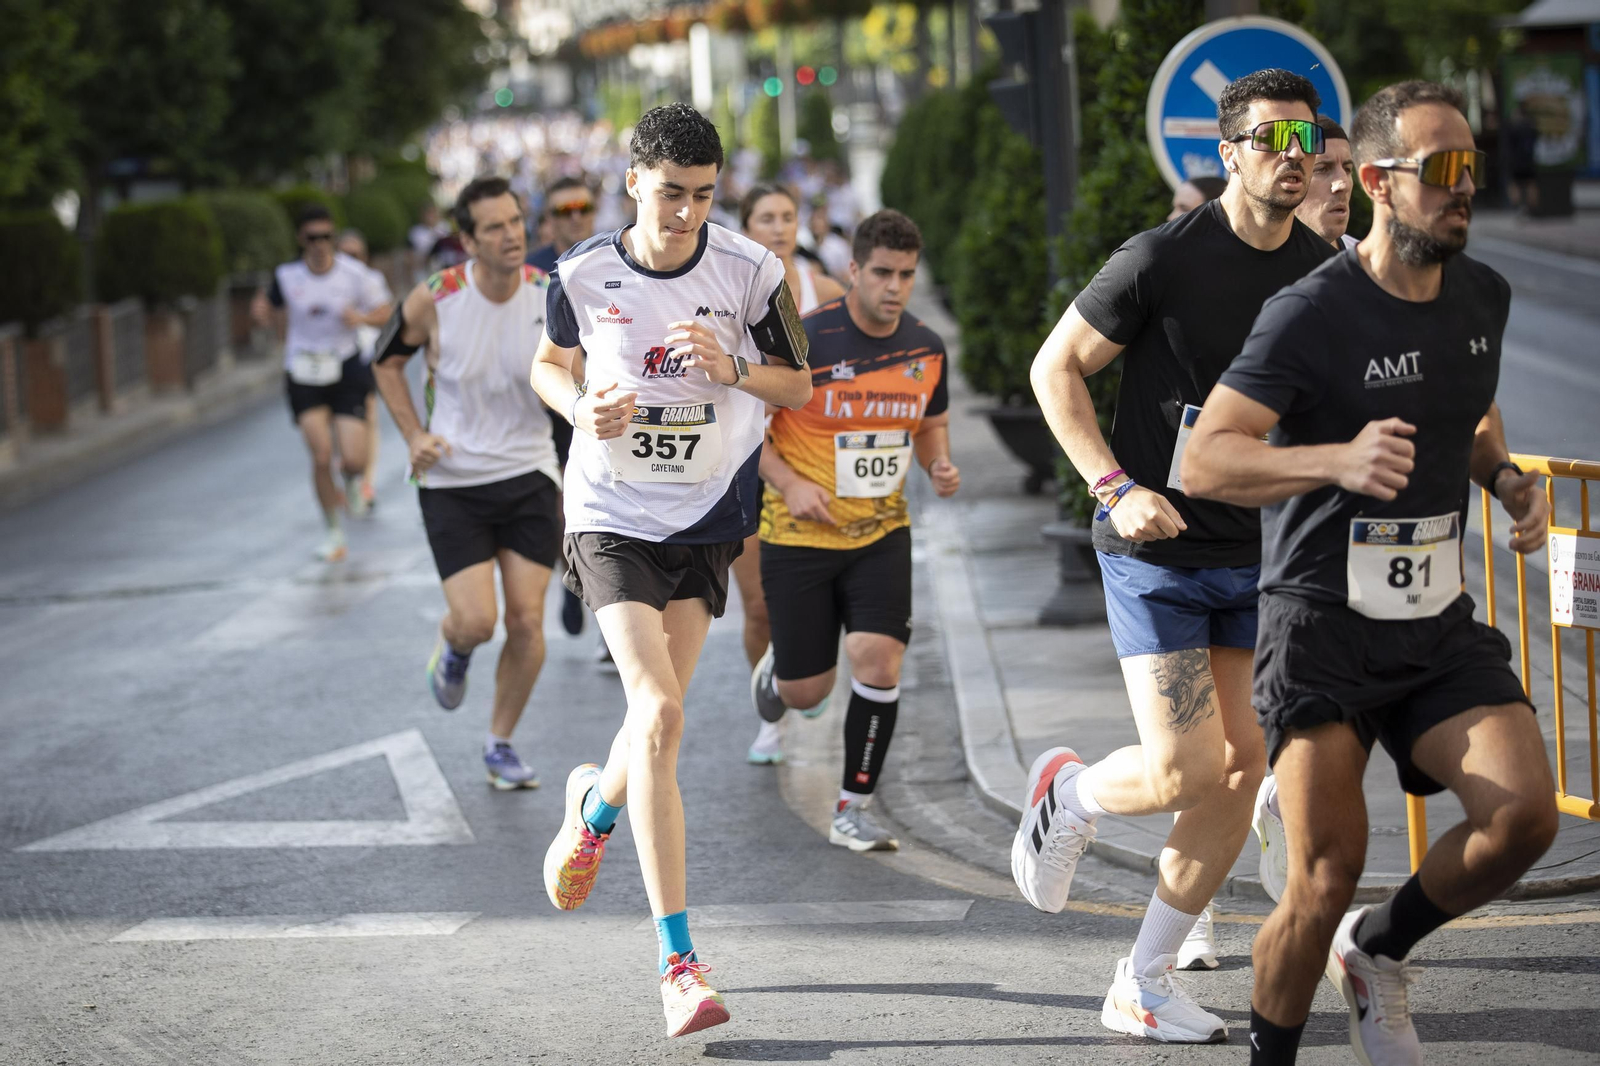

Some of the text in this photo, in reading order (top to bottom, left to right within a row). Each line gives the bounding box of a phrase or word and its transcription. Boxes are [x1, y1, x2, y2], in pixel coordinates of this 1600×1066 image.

[596, 315, 634, 325] Santander
[1363, 350, 1421, 381] AMT
[824, 389, 854, 419] LA
[837, 390, 918, 402] Club Deportivo
[660, 404, 706, 422] GRANADA
[631, 431, 701, 460] 357
[651, 463, 685, 474] CAYETANO
[854, 455, 898, 478] 605
[1387, 554, 1431, 589] 81
[1572, 571, 1600, 593] GRANA
[1405, 594, 1422, 605] AMT
